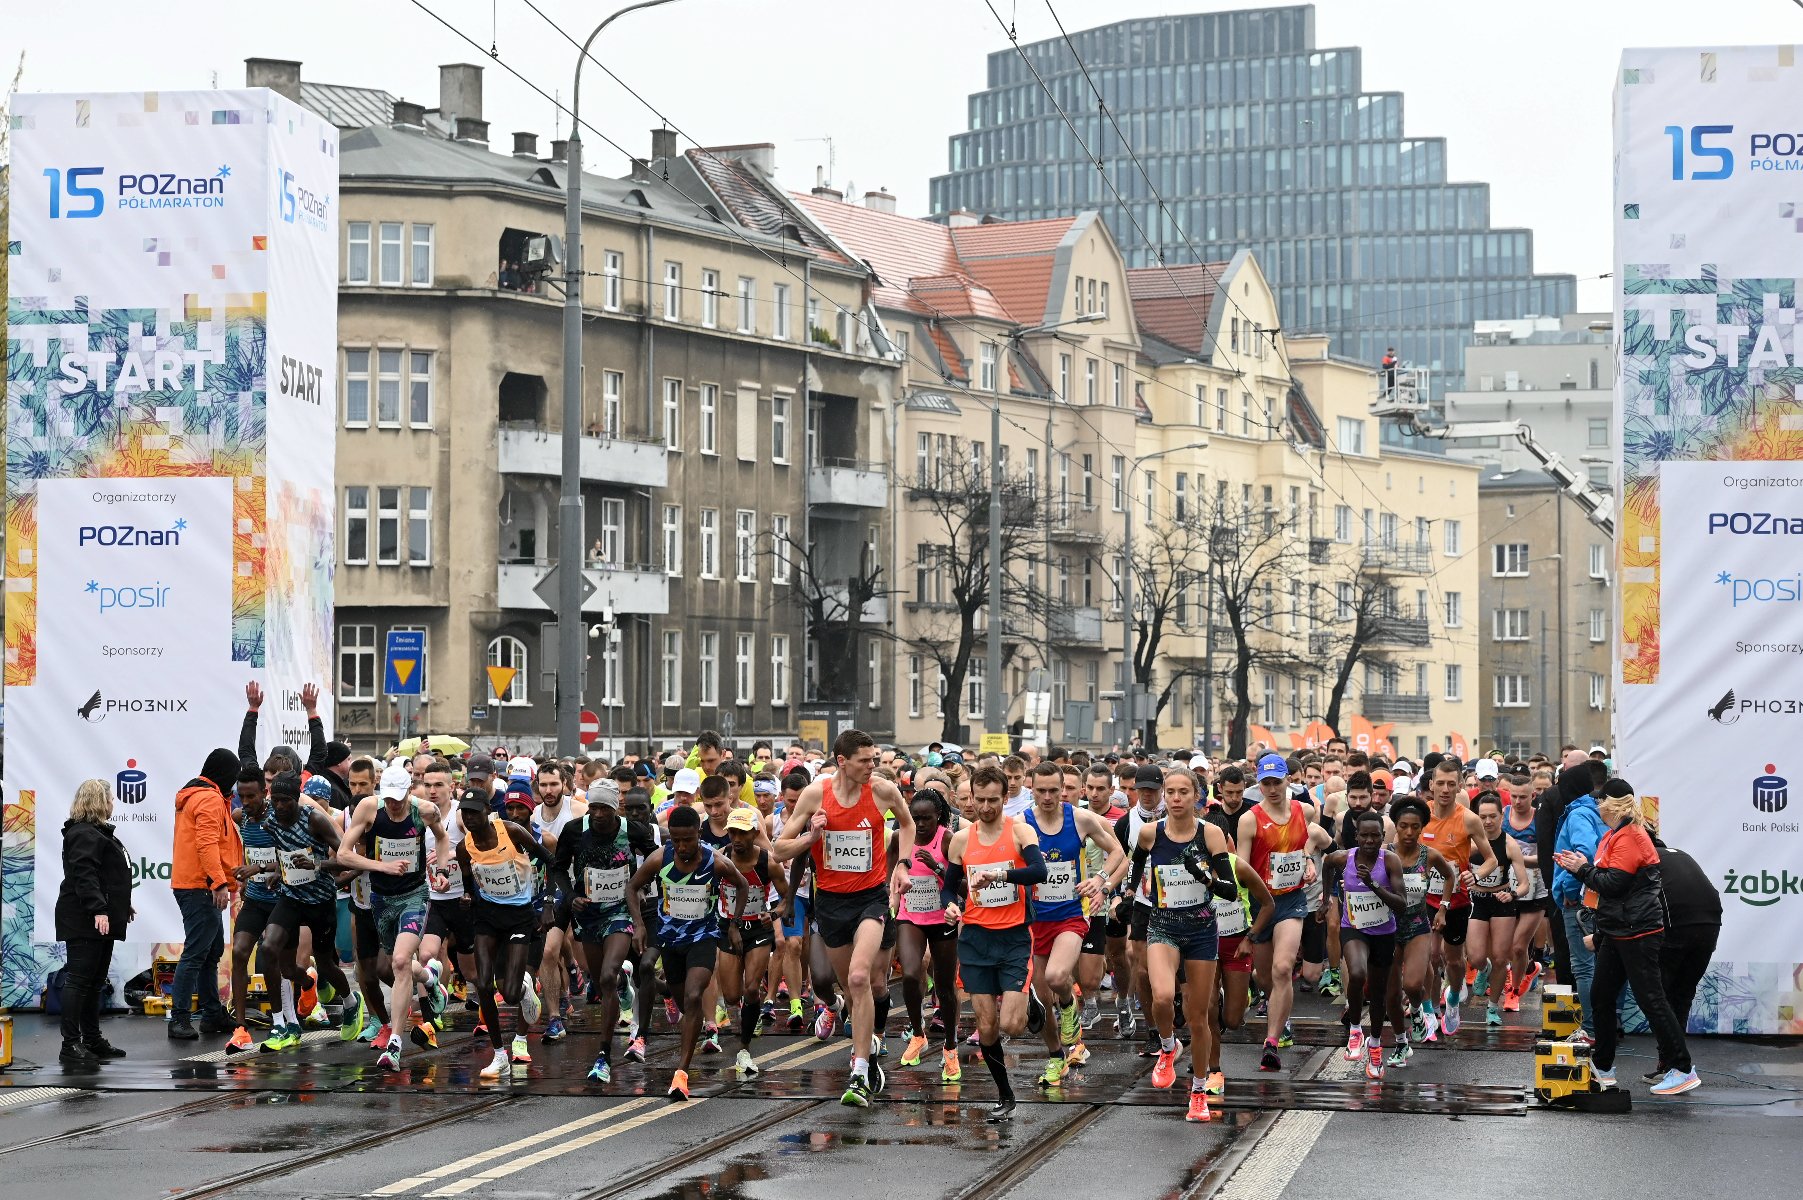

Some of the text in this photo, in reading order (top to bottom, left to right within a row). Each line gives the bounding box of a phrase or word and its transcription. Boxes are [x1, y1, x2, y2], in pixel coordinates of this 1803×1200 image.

[1664, 125, 1734, 180] 15
[1750, 157, 1803, 171] PÓŁM
[43, 167, 104, 219] 15
[278, 167, 295, 224] 15
[119, 196, 225, 209] PÓŁMARATON
[59, 350, 214, 393] START
[280, 354, 323, 406] START
[92, 491, 177, 505] Organizatorzy
[100, 581, 171, 614] posir
[102, 645, 164, 658] Sponsorzy
[131, 812, 157, 823] Polski
[1742, 822, 1799, 833] Bank Polski
[383, 849, 415, 857] ZALEWSKI
[834, 847, 866, 857] PACE
[1276, 861, 1301, 874] 6033
[485, 875, 512, 886] PACE
[595, 880, 624, 891] PACE
[1041, 873, 1070, 886] 459
[1723, 867, 1803, 895] żabk
